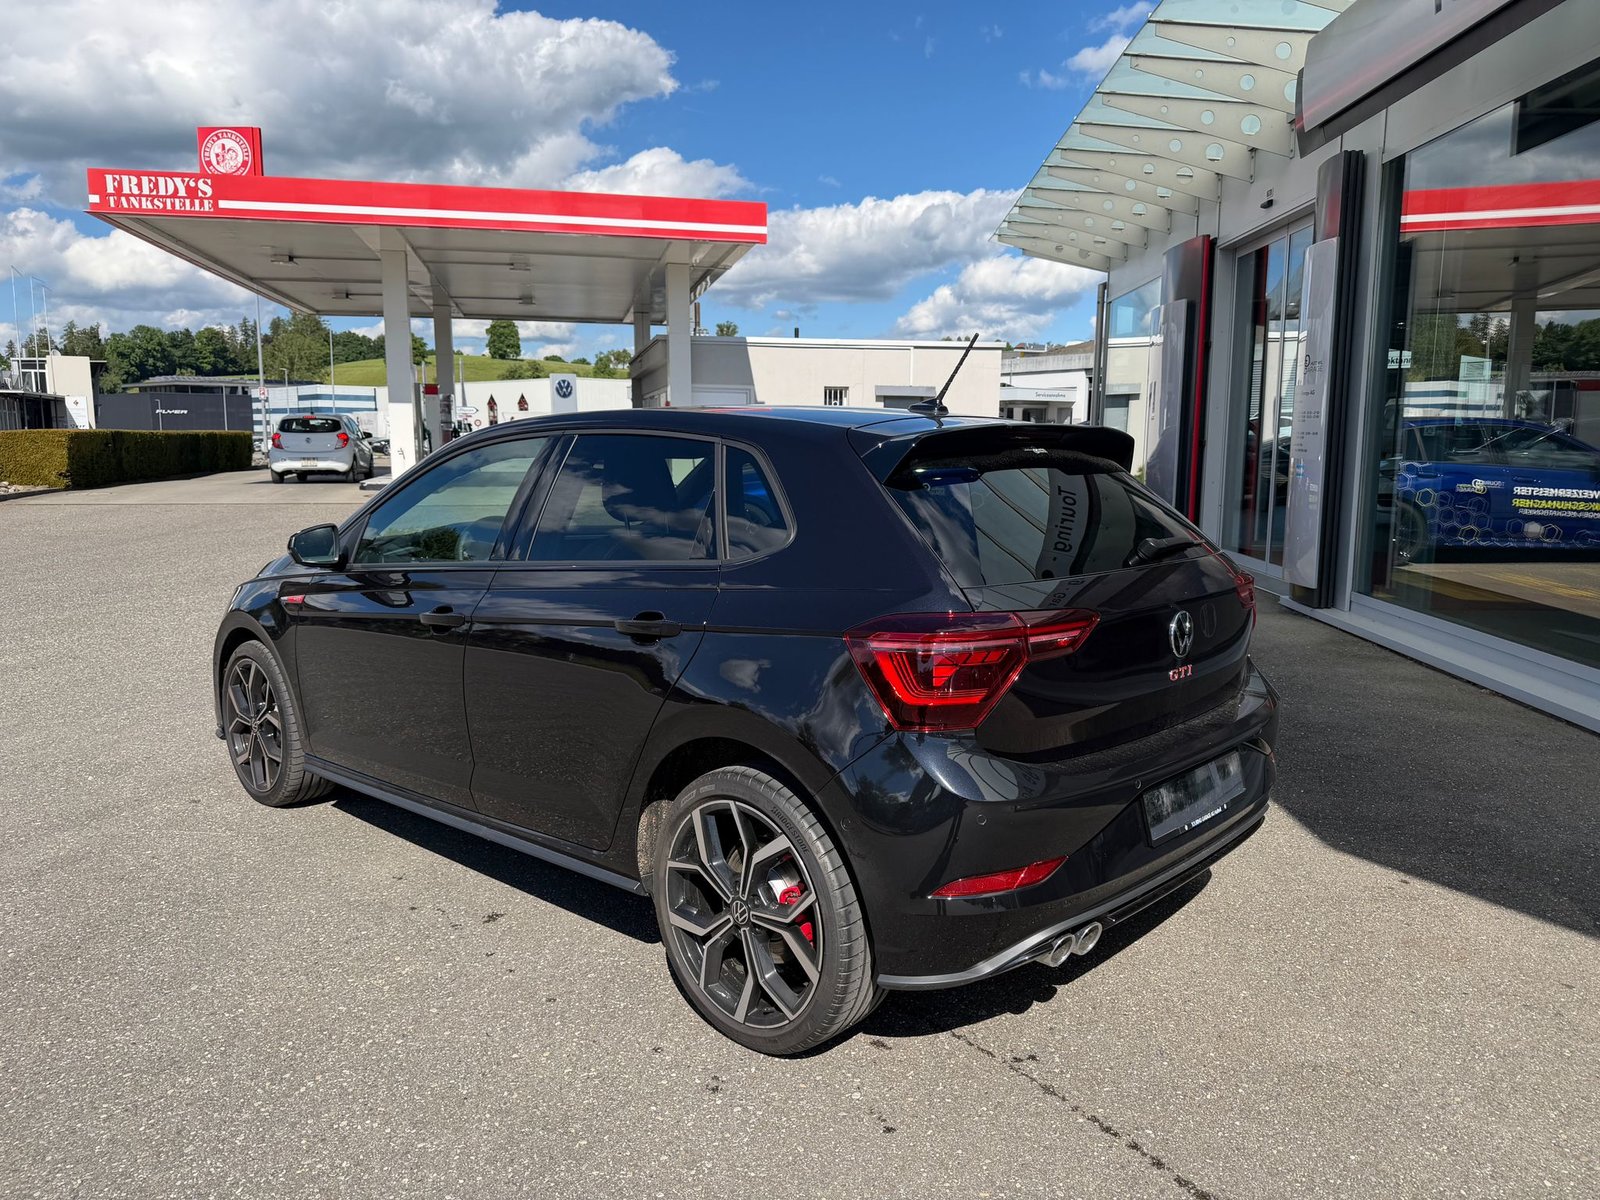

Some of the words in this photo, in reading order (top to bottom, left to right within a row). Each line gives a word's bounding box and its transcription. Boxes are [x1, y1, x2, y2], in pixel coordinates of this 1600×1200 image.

[104, 174, 213, 198] FREDY'S
[106, 195, 214, 212] TANKSTELLE
[1168, 664, 1193, 681] GTI
